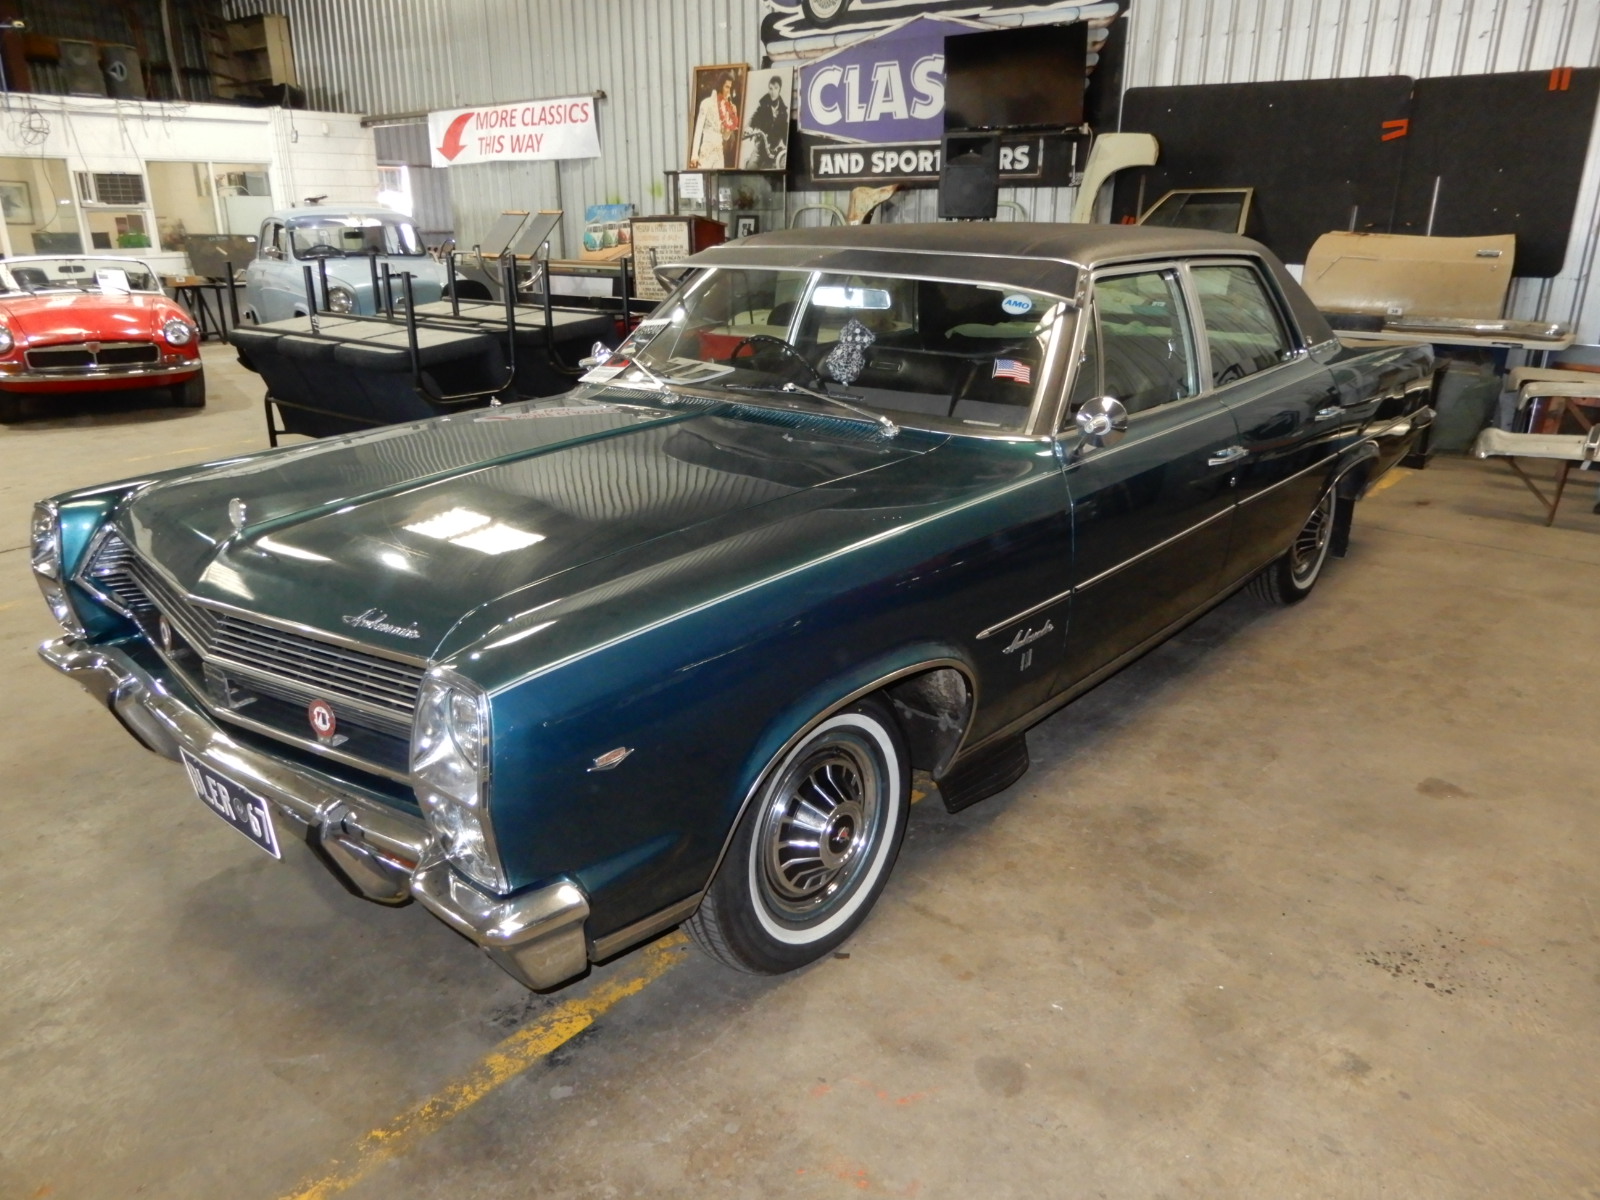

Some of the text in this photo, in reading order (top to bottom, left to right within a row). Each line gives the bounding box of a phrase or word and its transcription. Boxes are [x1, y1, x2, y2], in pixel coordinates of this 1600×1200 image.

[476, 103, 590, 131] MORE CLASSICS
[478, 133, 544, 155] THIS WAY
[818, 152, 865, 175] AND
[1005, 299, 1030, 310] AMO
[246, 802, 271, 845] 67
